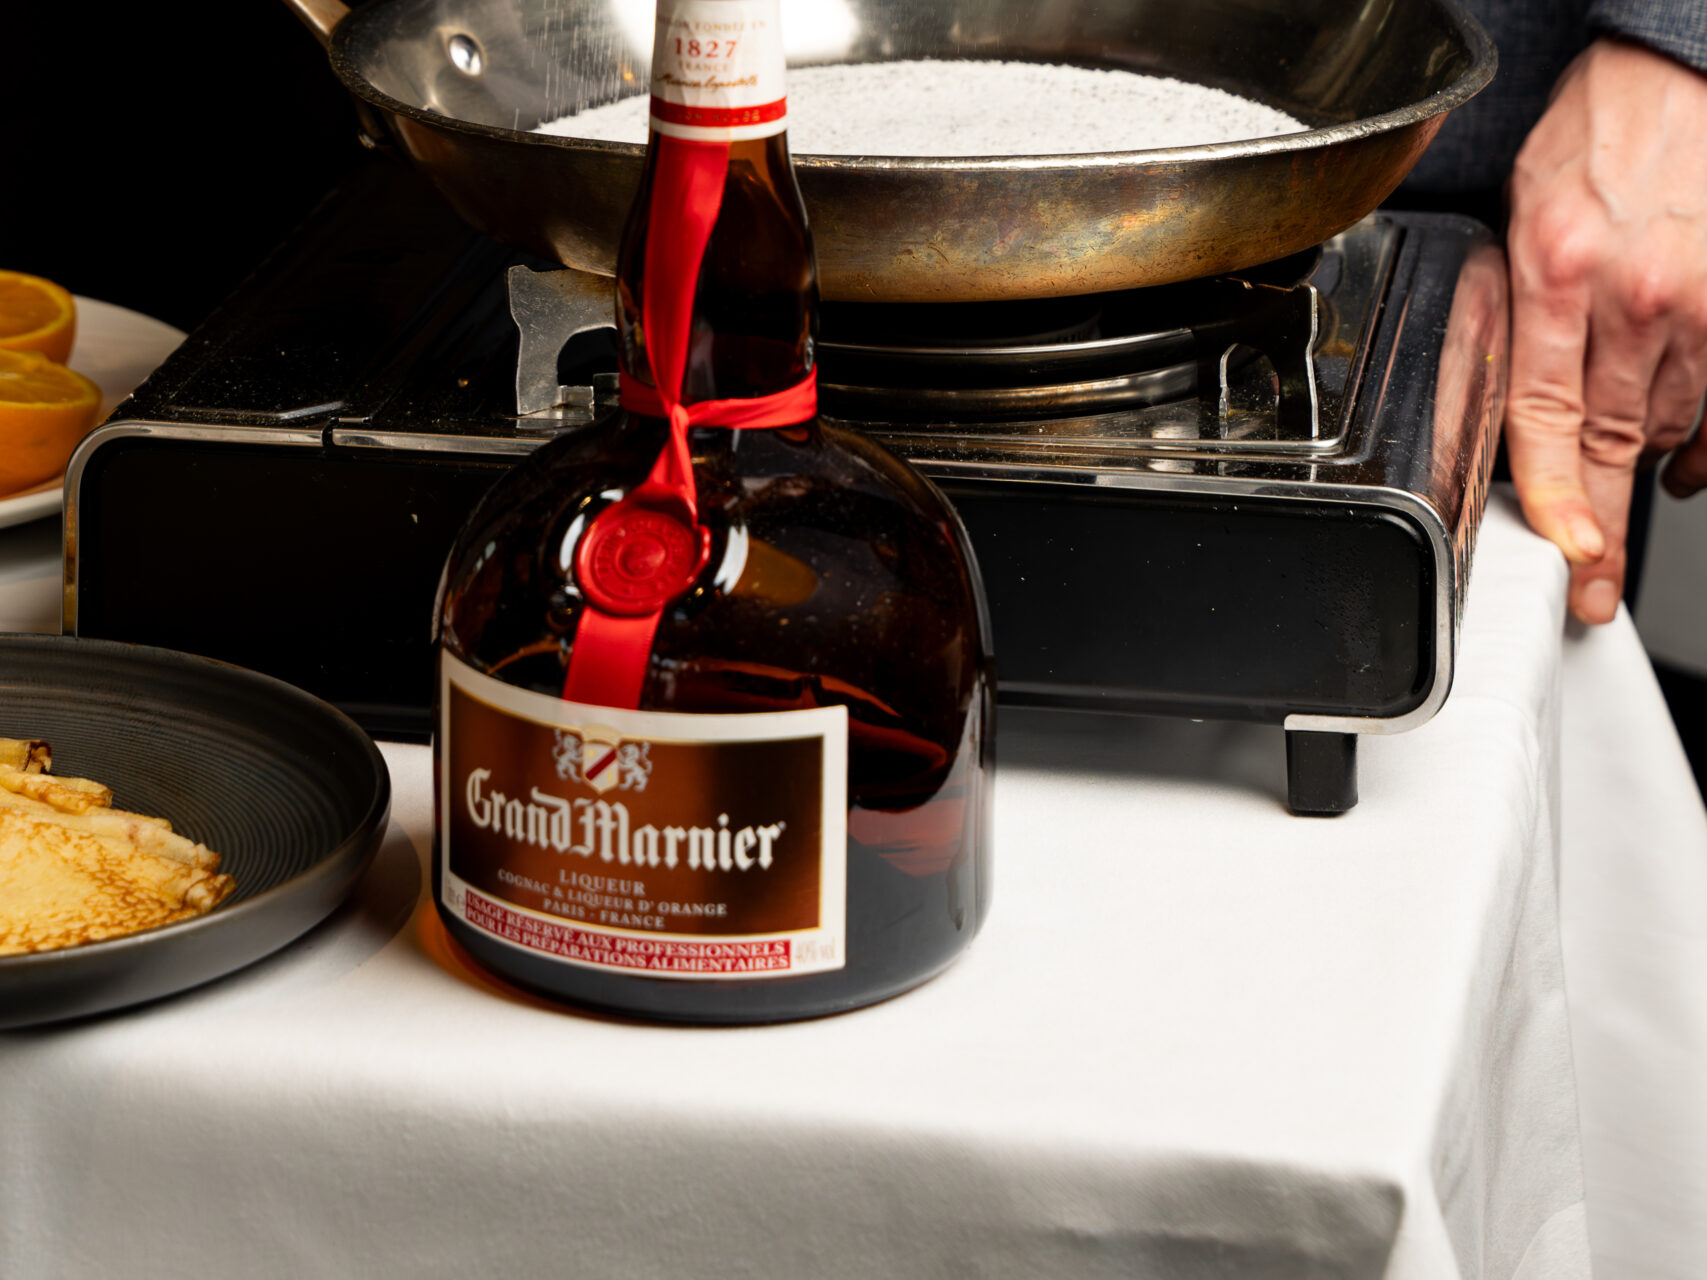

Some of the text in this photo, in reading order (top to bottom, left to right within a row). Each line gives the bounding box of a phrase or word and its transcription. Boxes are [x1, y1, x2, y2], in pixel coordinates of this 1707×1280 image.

[675, 37, 737, 58] 1827
[465, 766, 781, 872] Grand Marnier
[497, 868, 550, 895] COGNAC
[553, 886, 564, 899] &
[567, 888, 634, 913] LIQUEUR
[657, 901, 728, 917] ORANGE
[559, 869, 646, 897] LIQUEUR
[467, 892, 505, 920] USAGE
[576, 932, 612, 950] AUX
[615, 937, 786, 958] PROFESSIONNELS
[543, 898, 585, 918] PARIS
[600, 909, 665, 929] FRANCE
[467, 907, 497, 933] POUR
[498, 921, 521, 941] LES
[648, 954, 789, 971] ALIMENTAIRES
